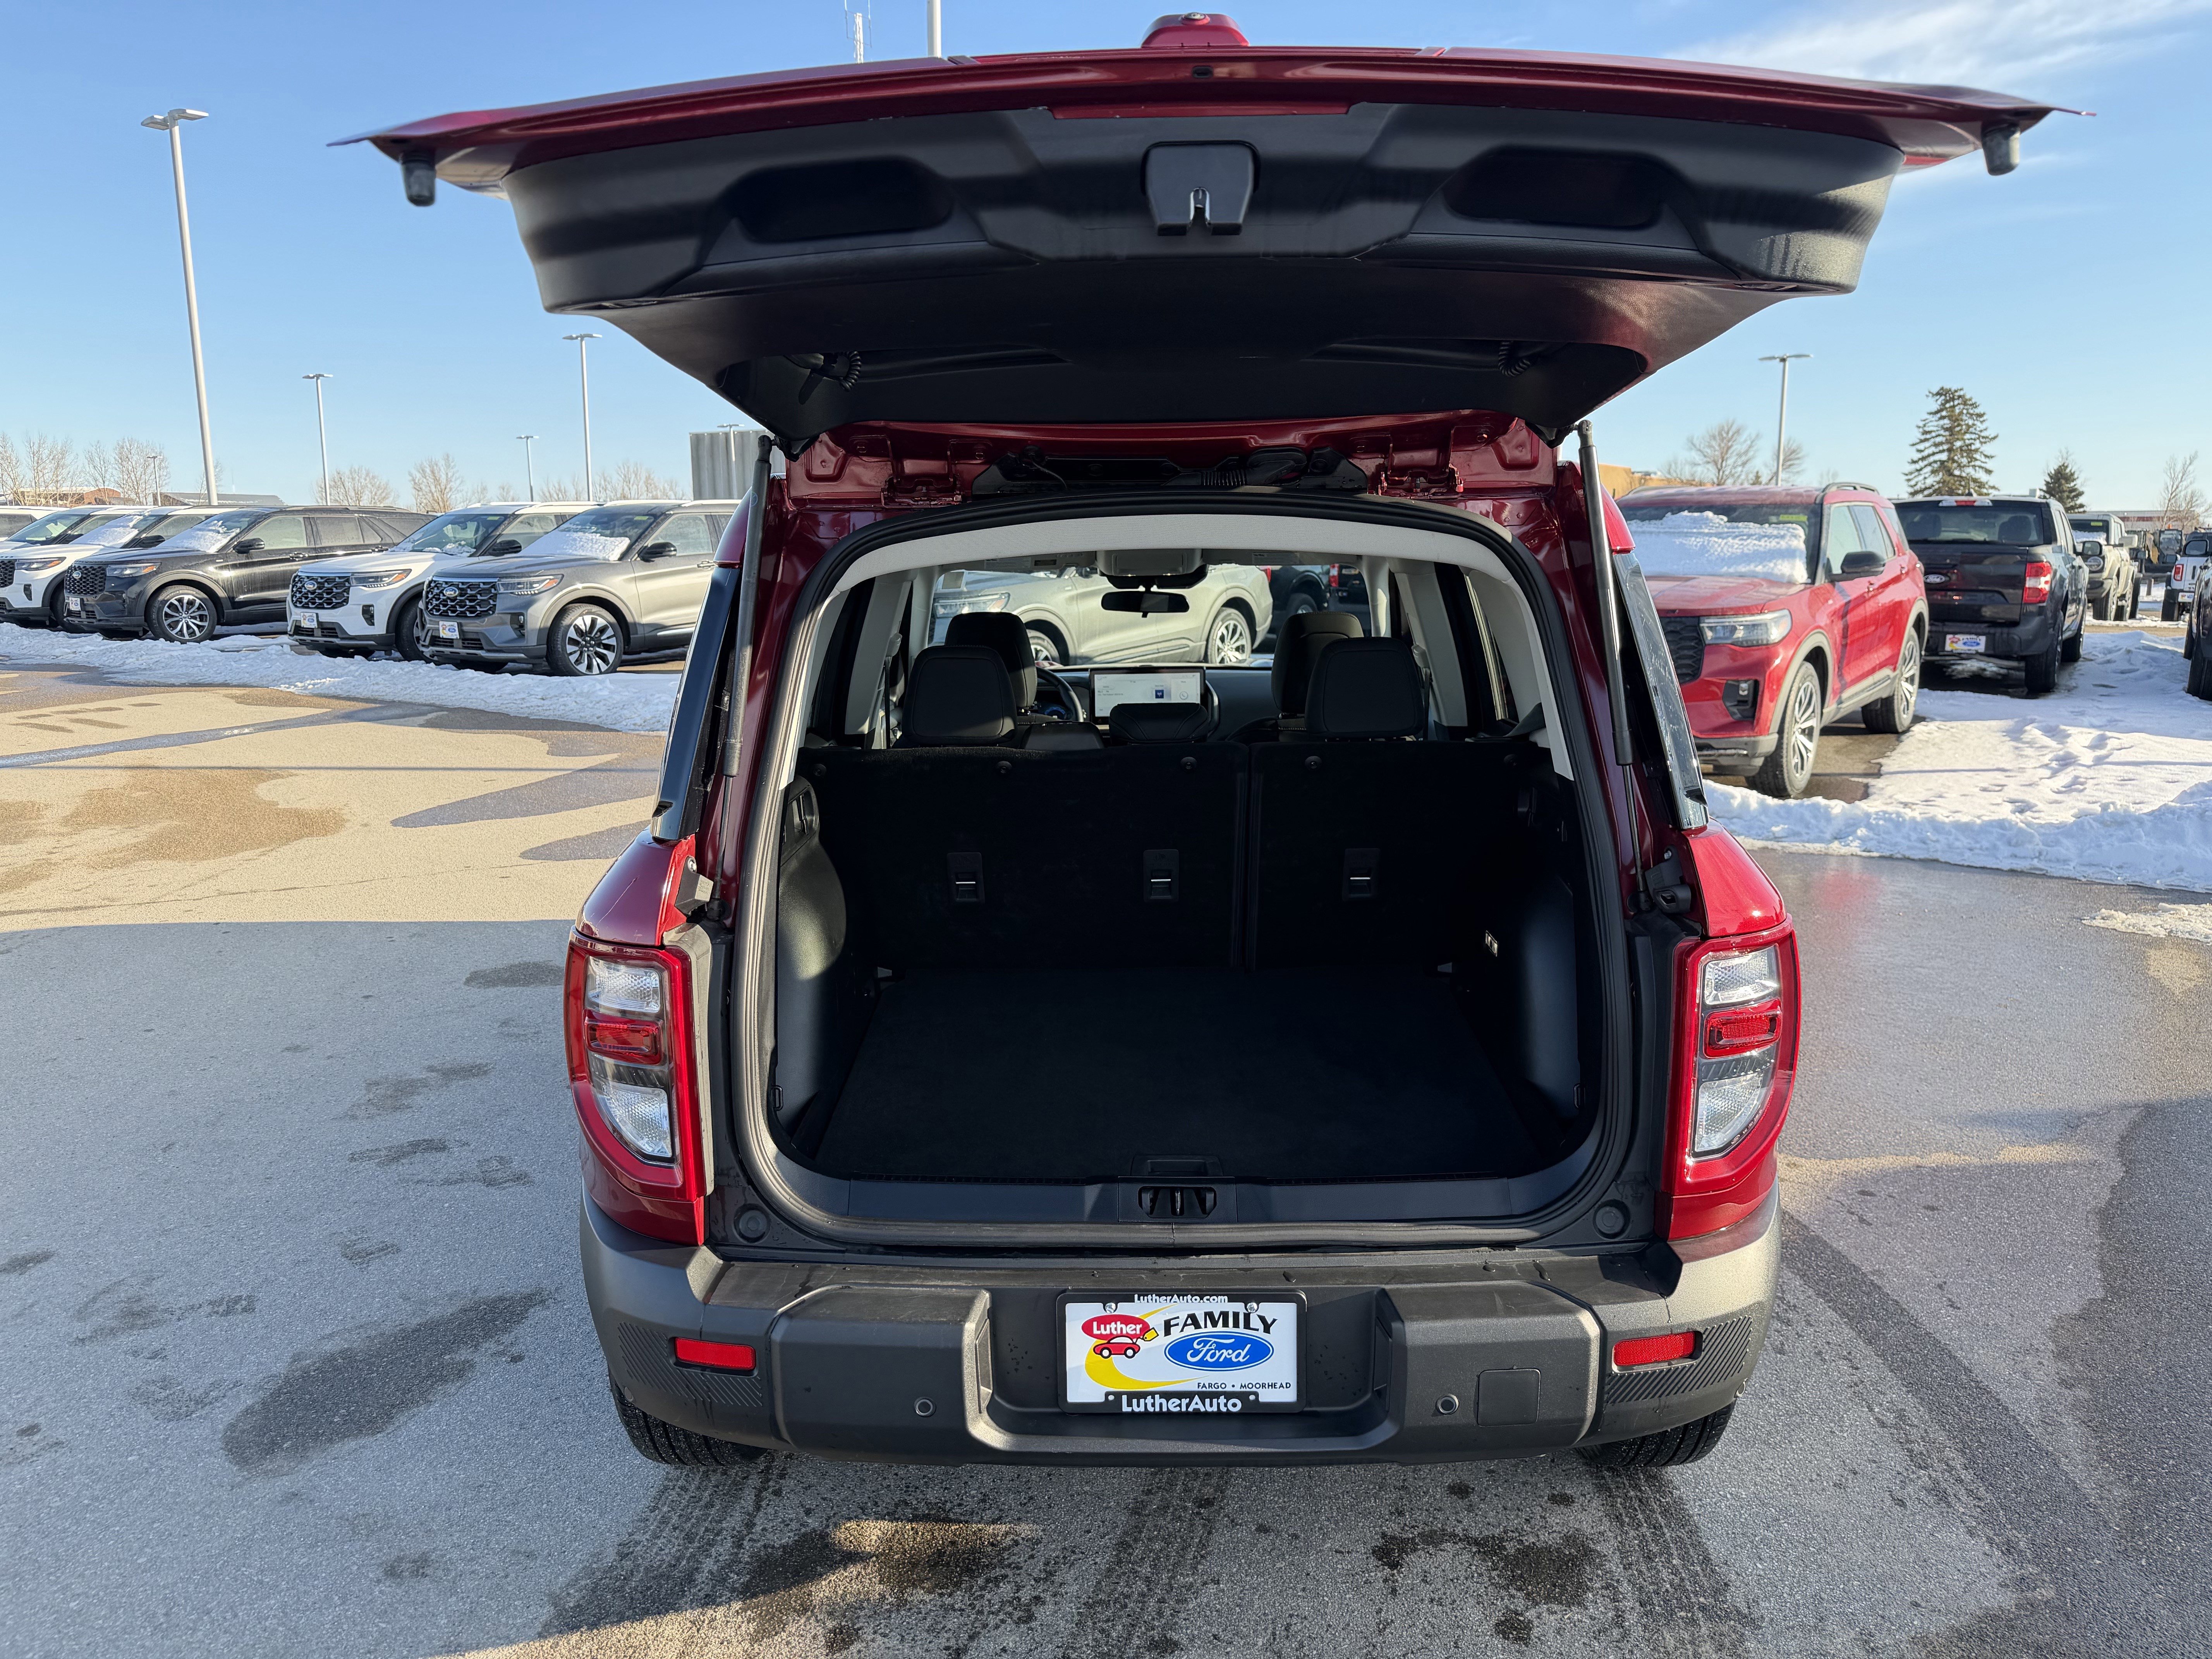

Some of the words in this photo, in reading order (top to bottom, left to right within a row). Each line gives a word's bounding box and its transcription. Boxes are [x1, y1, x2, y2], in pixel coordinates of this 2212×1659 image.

[1134, 1294, 1228, 1303] LutherAuto.com
[1092, 1321, 1142, 1334] Luther
[1163, 1310, 1278, 1337] FAMILY
[1187, 1337, 1251, 1362] Ford
[1122, 1395, 1242, 1412] LutherAuto
